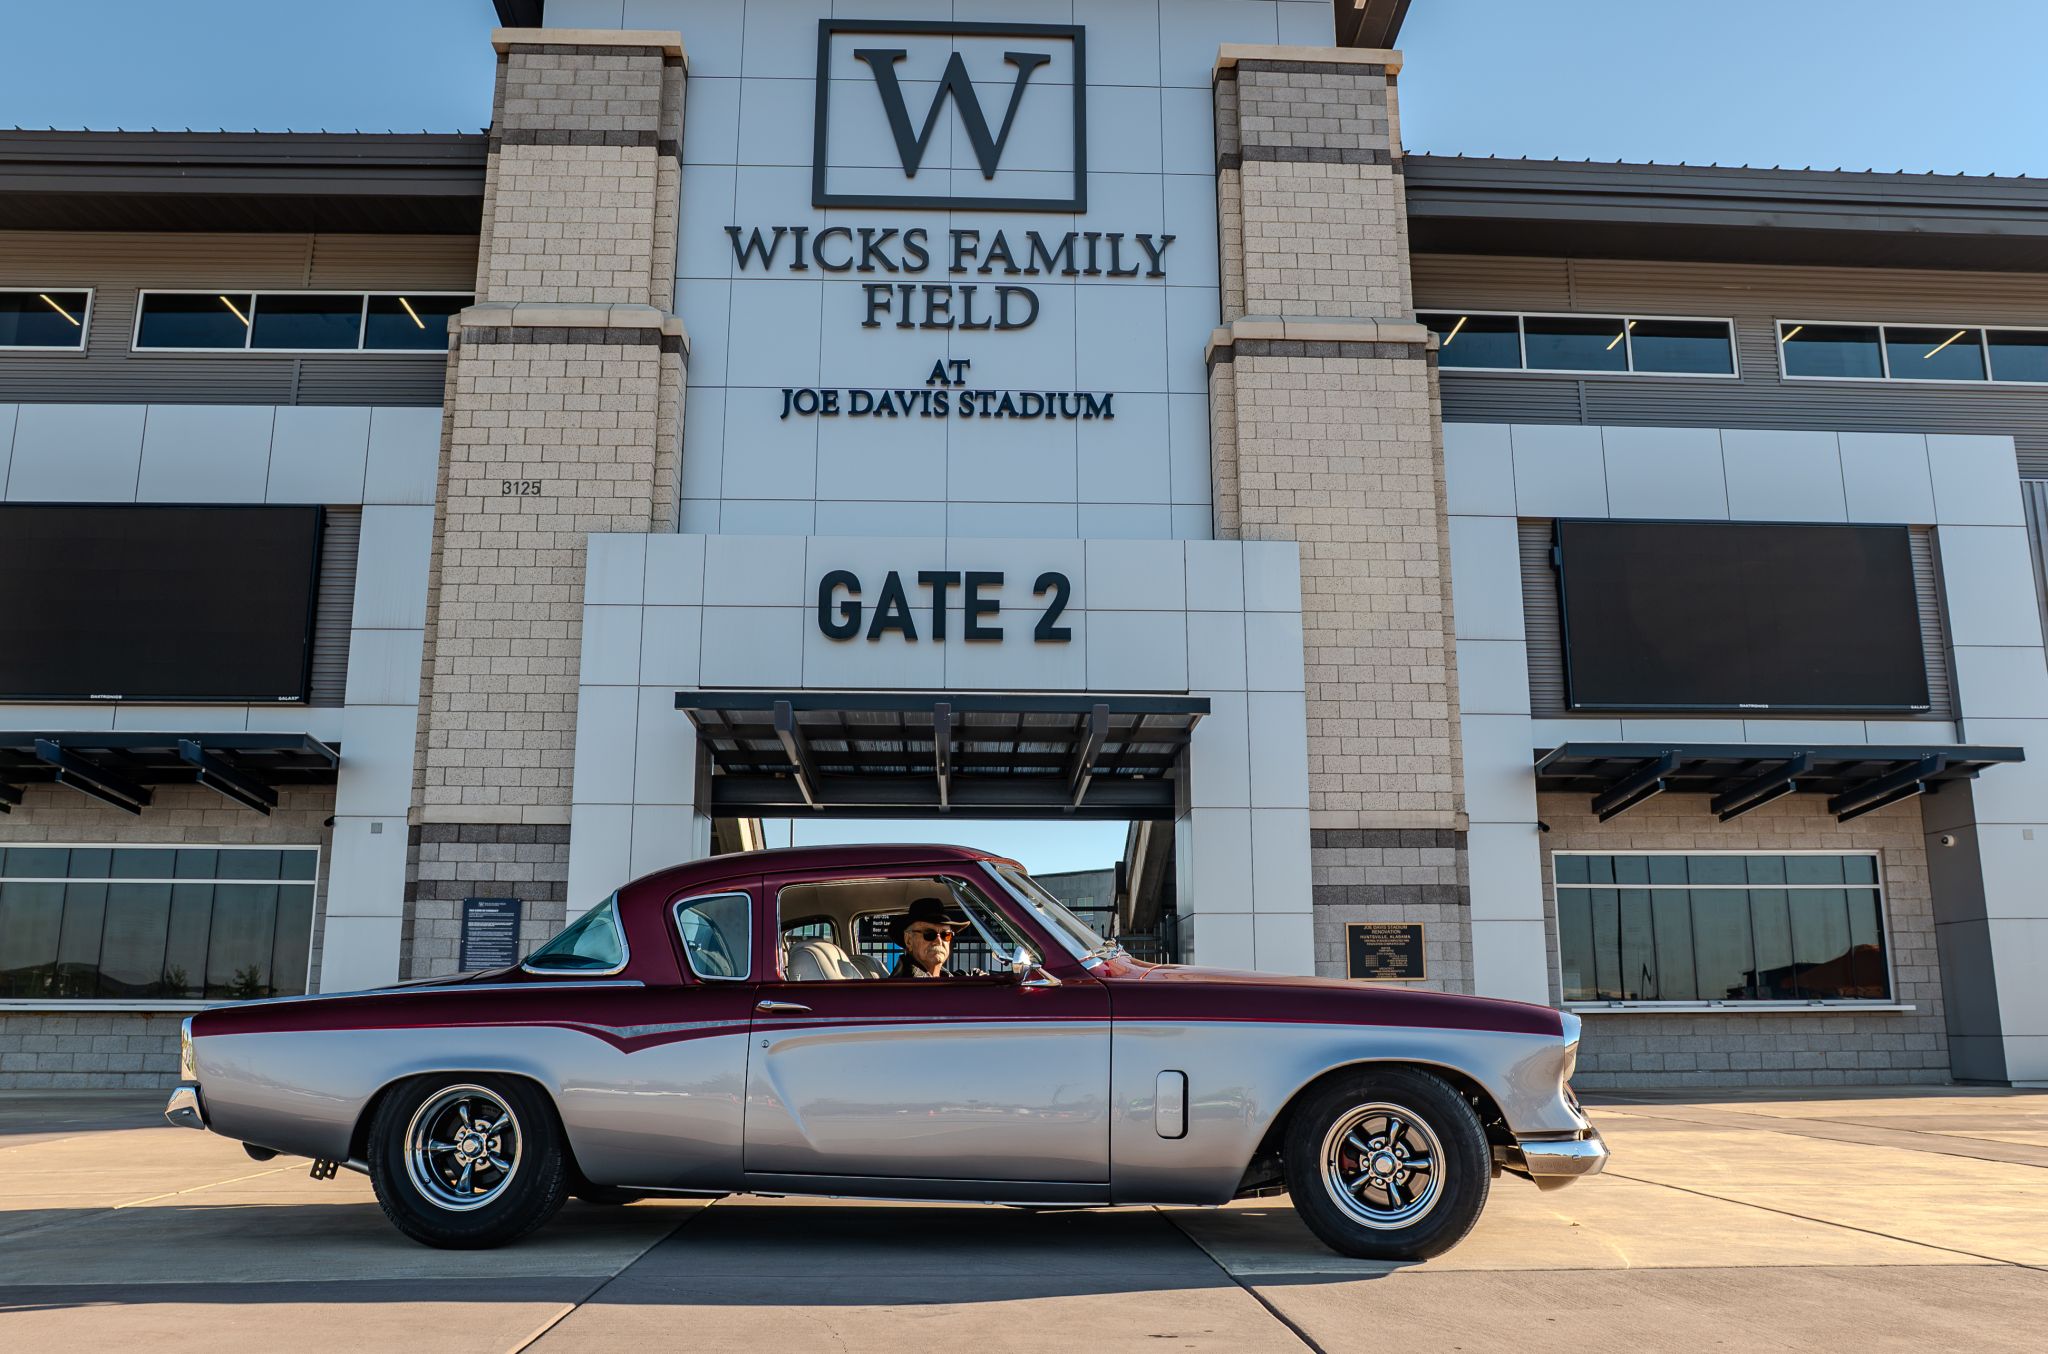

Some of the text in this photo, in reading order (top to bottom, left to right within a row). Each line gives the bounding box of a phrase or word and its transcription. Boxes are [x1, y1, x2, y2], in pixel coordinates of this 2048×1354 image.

[853, 48, 1052, 181] W
[724, 226, 1176, 279] WICKS FAMILY
[861, 283, 1040, 332] FIELD
[926, 358, 971, 388] AT
[780, 388, 1115, 421] JOE DAVIS STADIUM
[503, 480, 541, 496] 3125
[818, 569, 1073, 643] GATE 2
